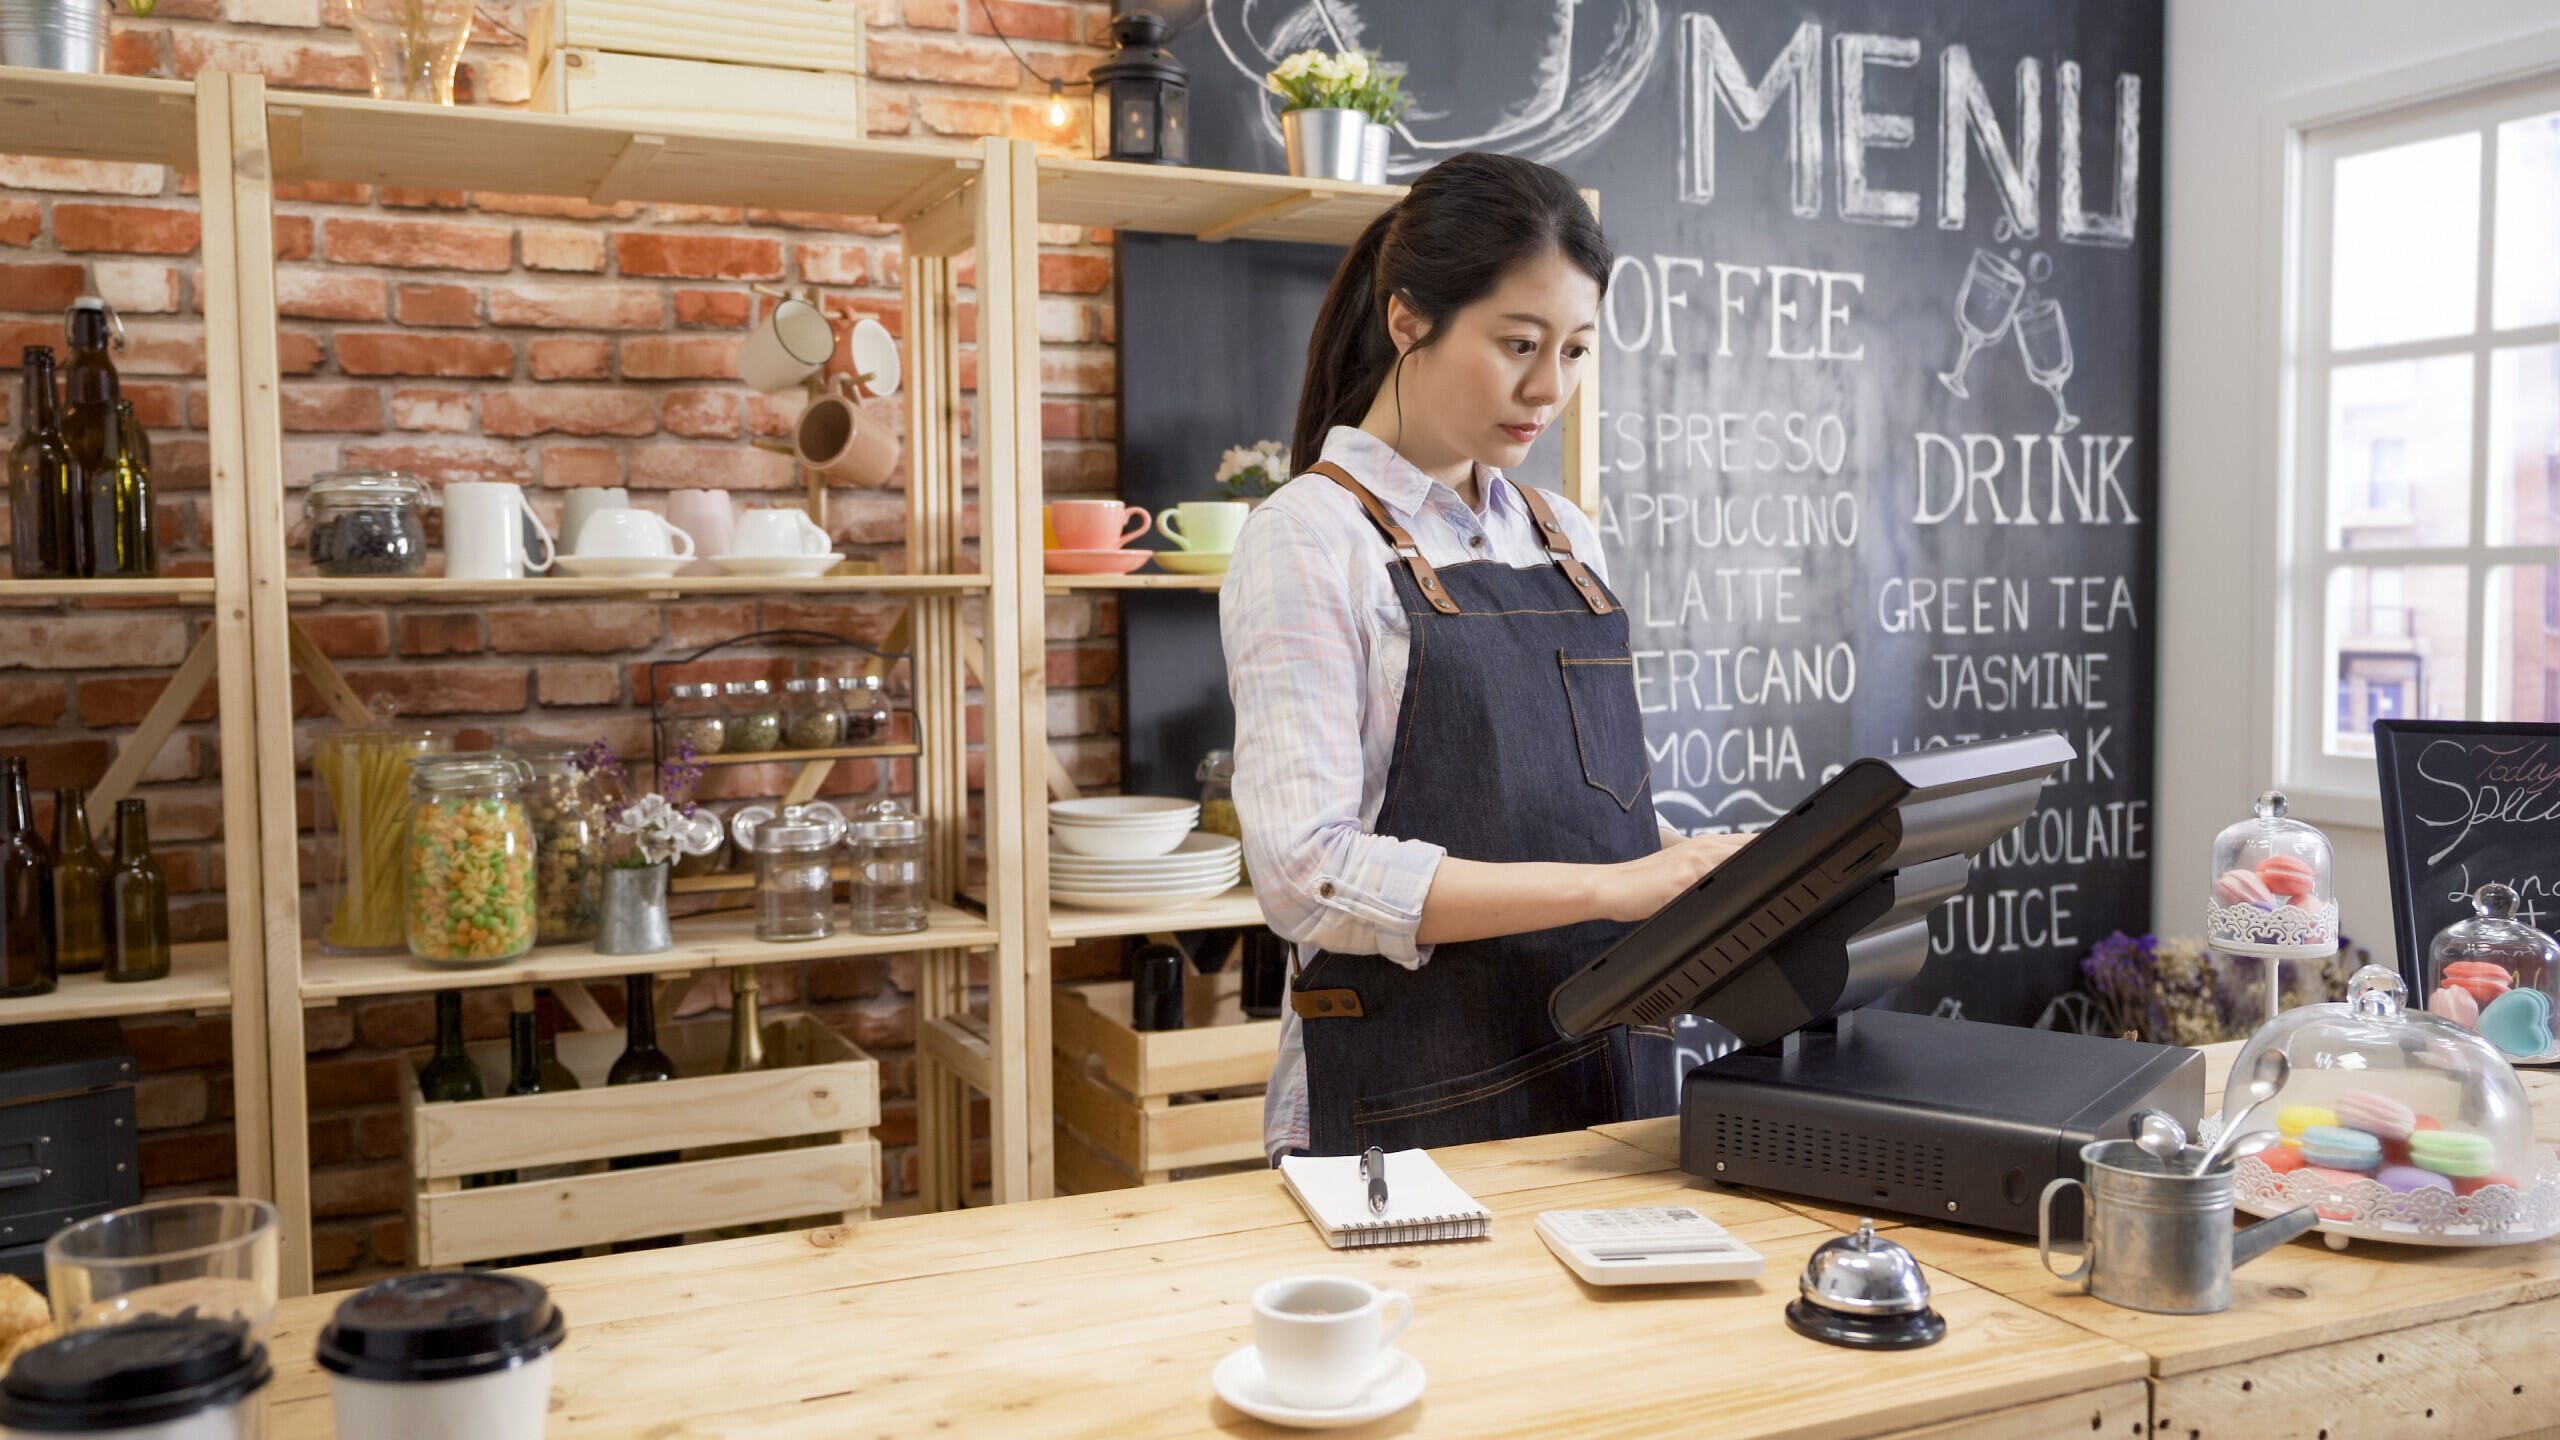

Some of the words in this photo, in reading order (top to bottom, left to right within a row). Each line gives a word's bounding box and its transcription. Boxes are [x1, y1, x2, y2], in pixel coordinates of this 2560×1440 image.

[1679, 11, 2141, 249] MENU
[1605, 254, 1864, 360] OFFEE
[1912, 431, 2140, 525] DRINK
[1598, 491, 1858, 549] APPUCCINO
[1643, 567, 1802, 627] LATTE
[1878, 577, 2029, 634] GREEN
[2050, 575, 2138, 632] TEA
[1632, 641, 1857, 712] ERICANO
[1926, 652, 2109, 710] JASMINE
[1973, 800, 2147, 869] OCOLATE
[1931, 884, 2078, 955] JUICE
